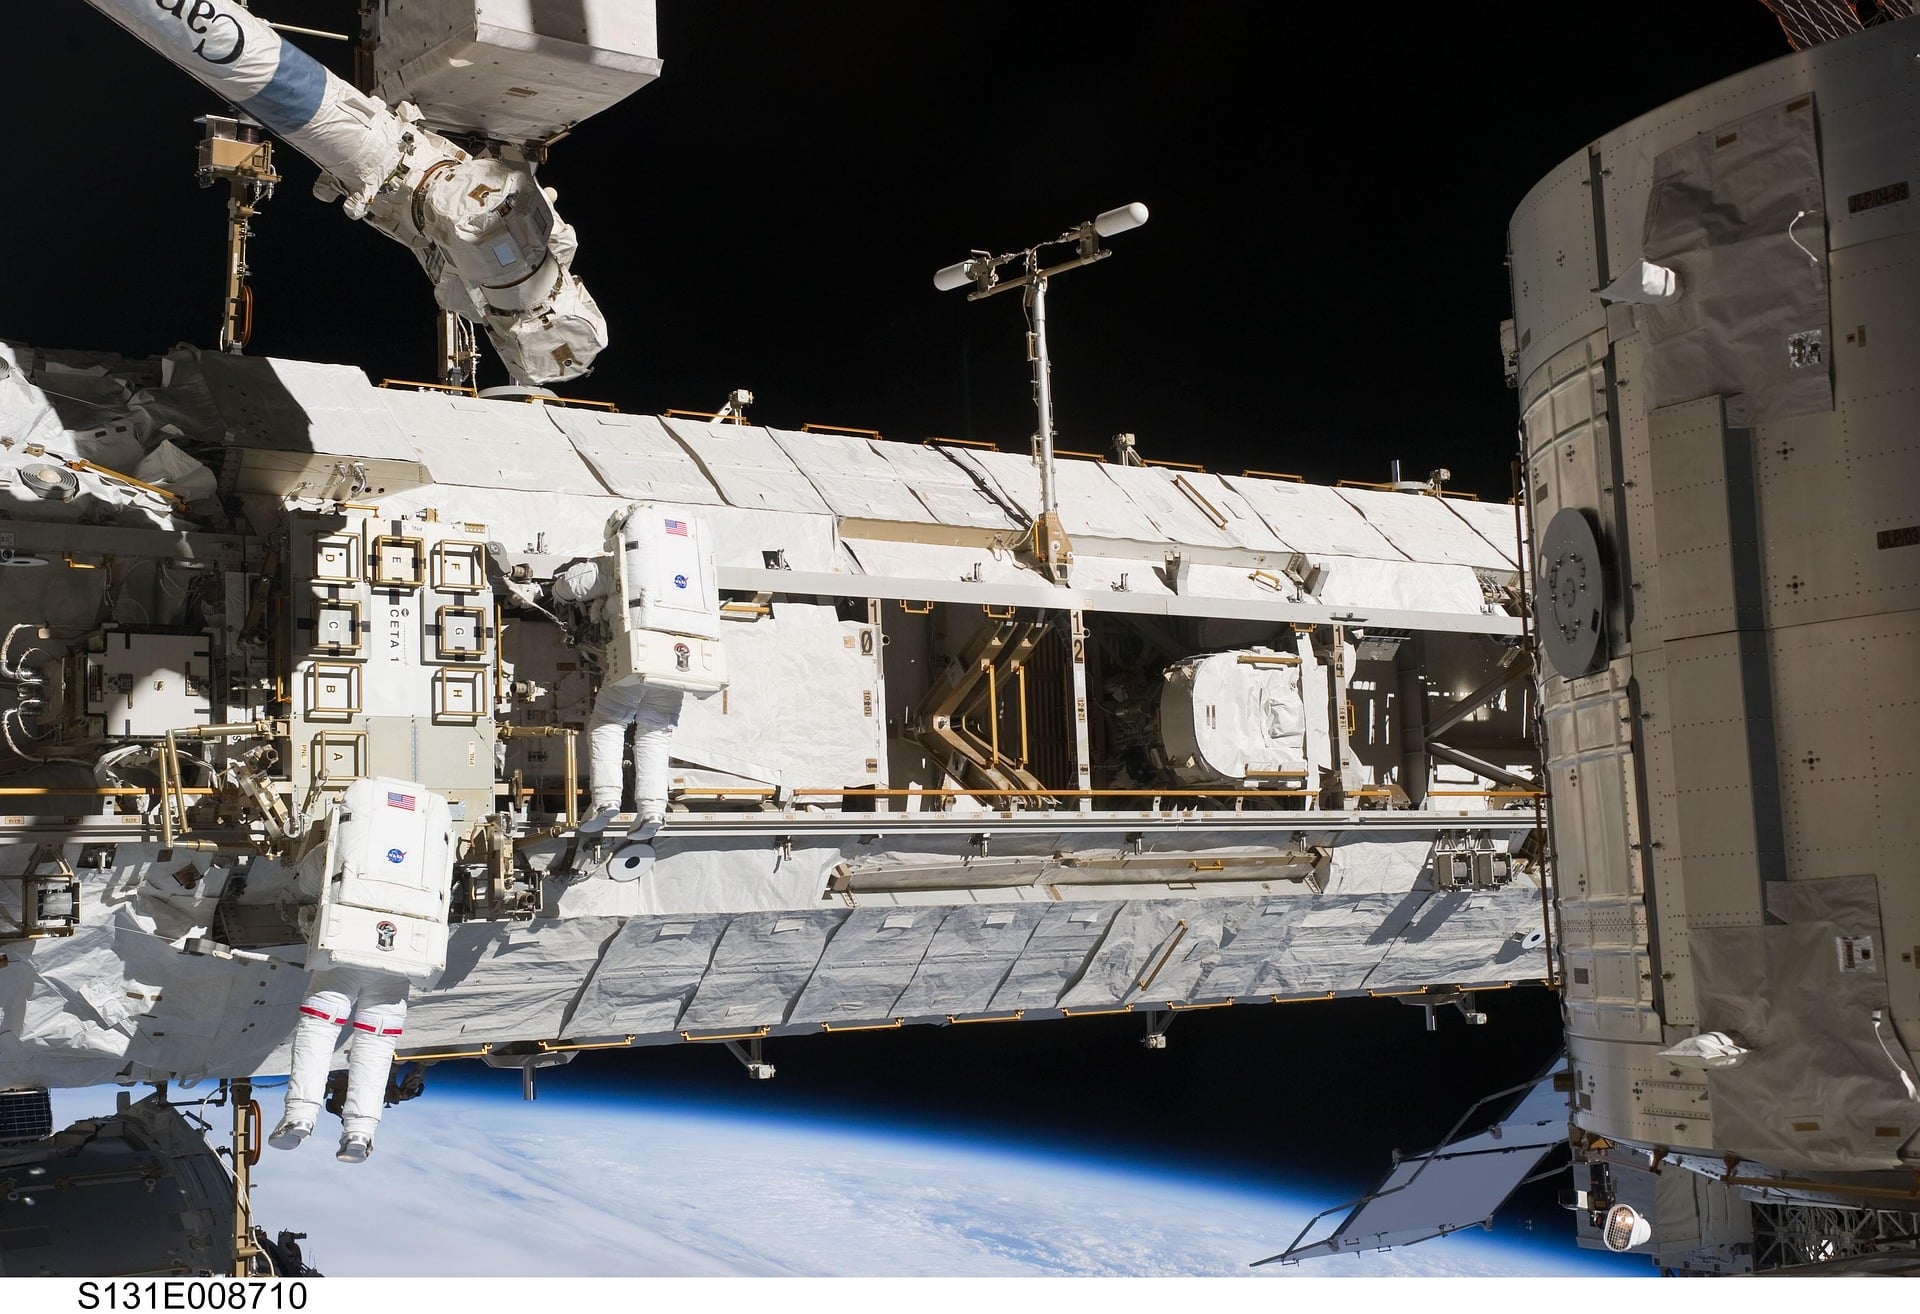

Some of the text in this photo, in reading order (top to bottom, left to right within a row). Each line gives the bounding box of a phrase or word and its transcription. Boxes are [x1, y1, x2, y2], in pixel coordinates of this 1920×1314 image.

[1879, 527, 1920, 549] JLP/03
[325, 553, 335, 562] D
[392, 556, 402, 564] E
[451, 562, 461, 571] F
[328, 620, 339, 629] C
[390, 609, 400, 648] CETA
[454, 627, 465, 636] G
[326, 685, 336, 693] B
[453, 689, 463, 698] H
[333, 752, 343, 761] A
